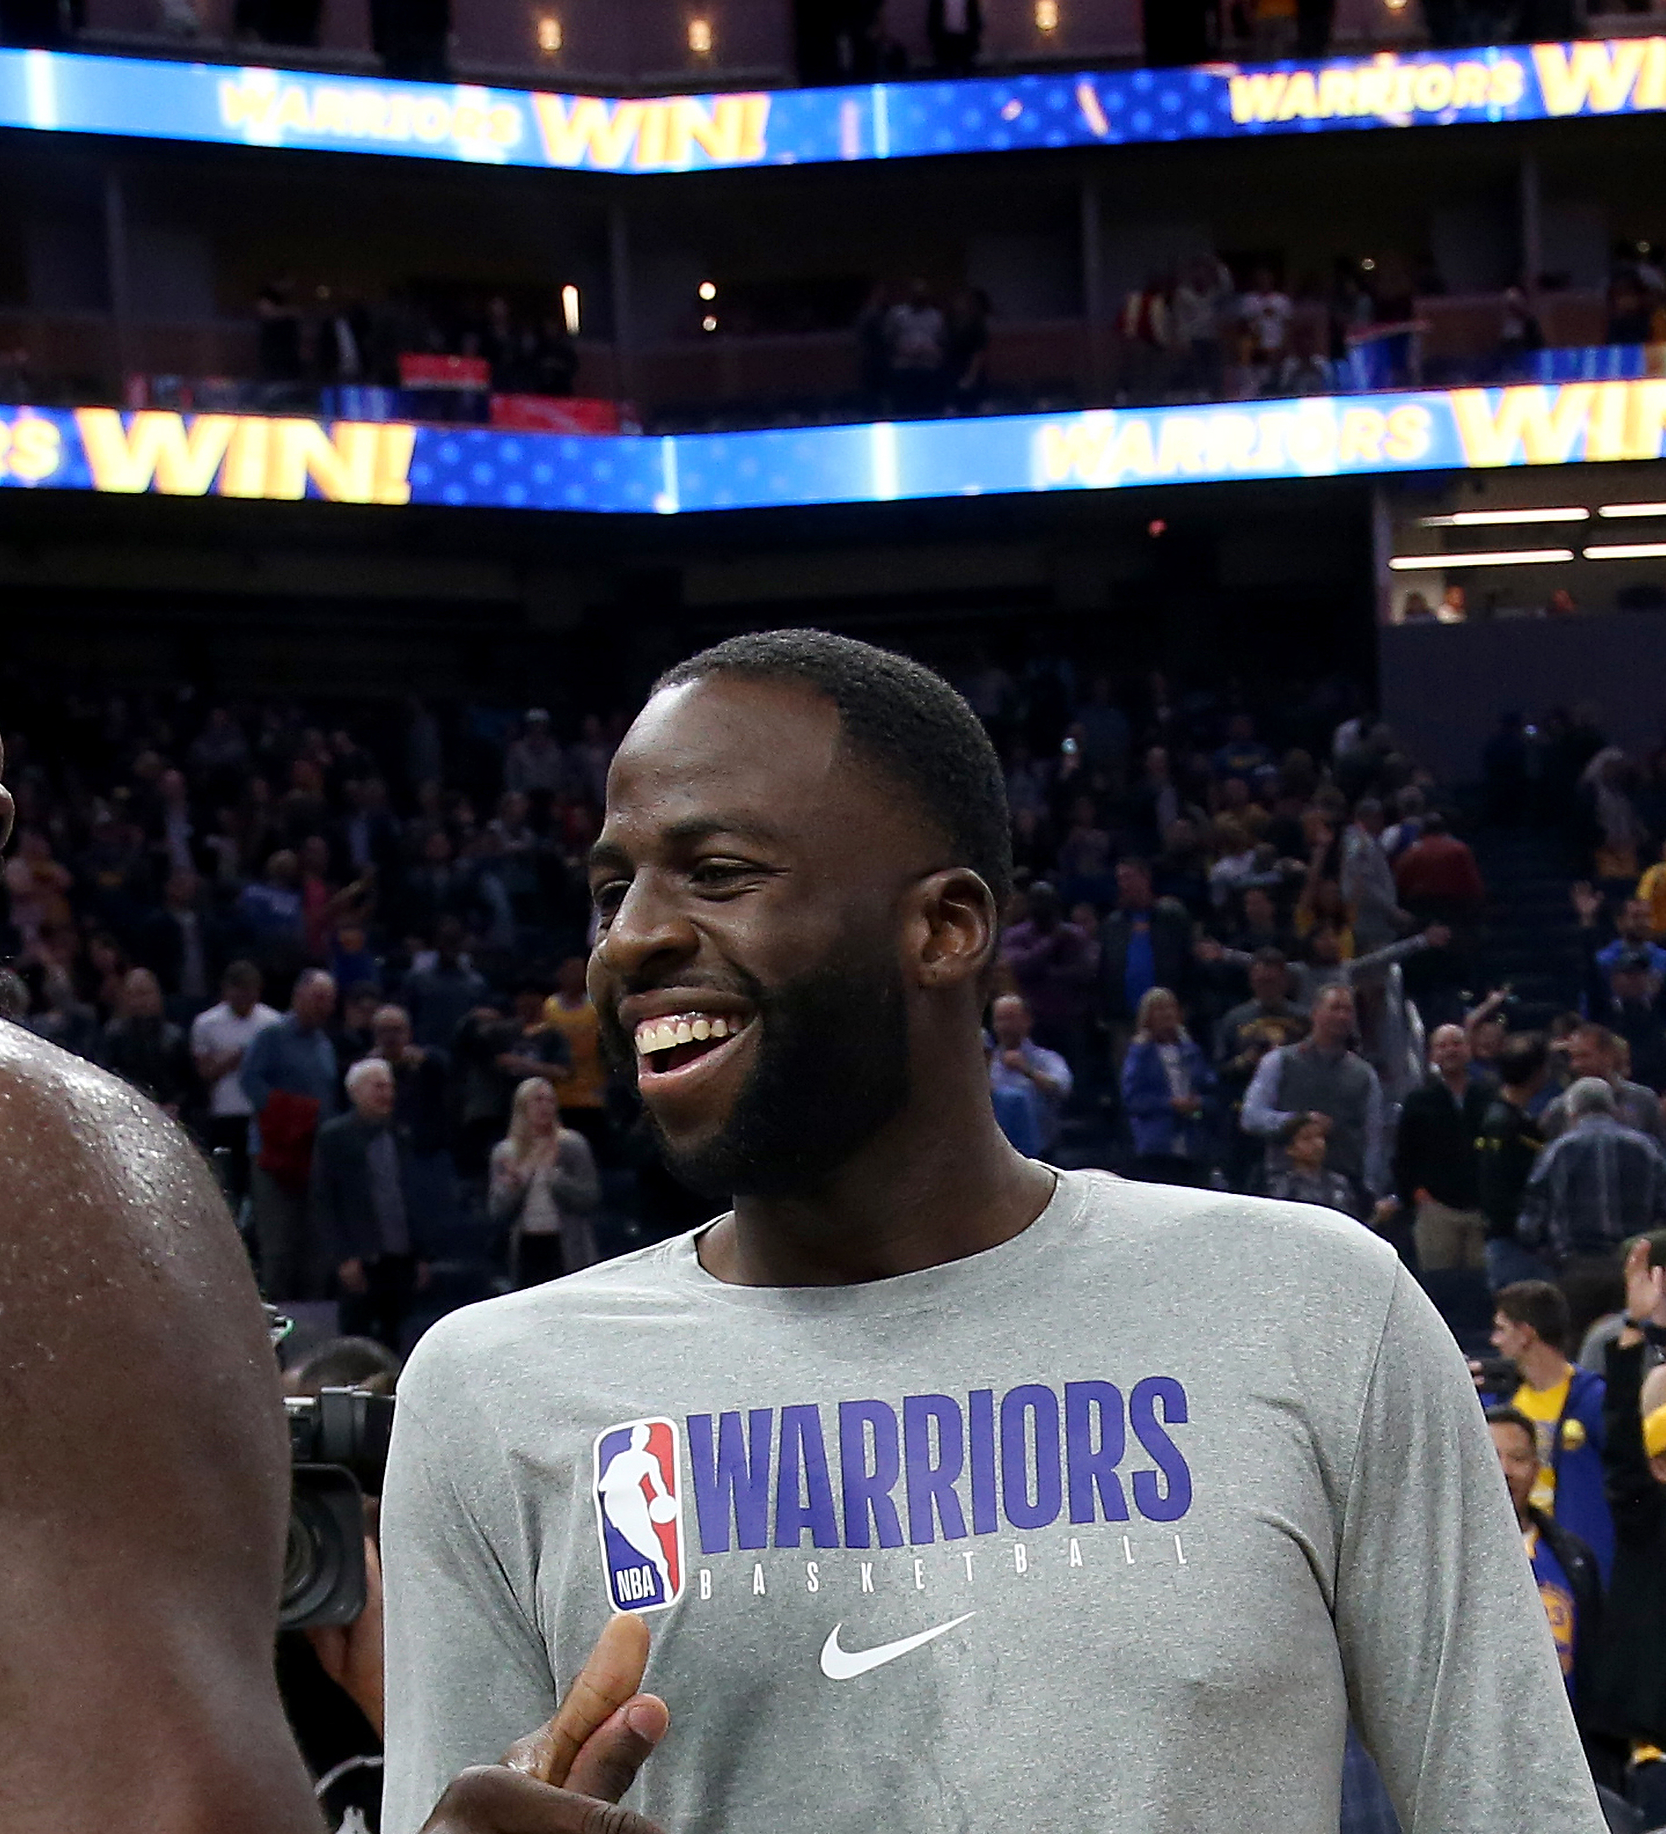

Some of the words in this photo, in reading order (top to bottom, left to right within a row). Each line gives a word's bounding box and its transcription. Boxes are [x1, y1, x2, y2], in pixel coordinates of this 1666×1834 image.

[220, 79, 522, 144] WARRIORS
[532, 90, 770, 167] WIN!
[1231, 60, 1524, 124] WARRIORS
[73, 405, 416, 507] WIN!
[1042, 404, 1433, 482] WARRIORS
[685, 1376, 1194, 1556] WARRIORS
[616, 1565, 656, 1602] NBA
[700, 1534, 1188, 1602] BASKETBALL
